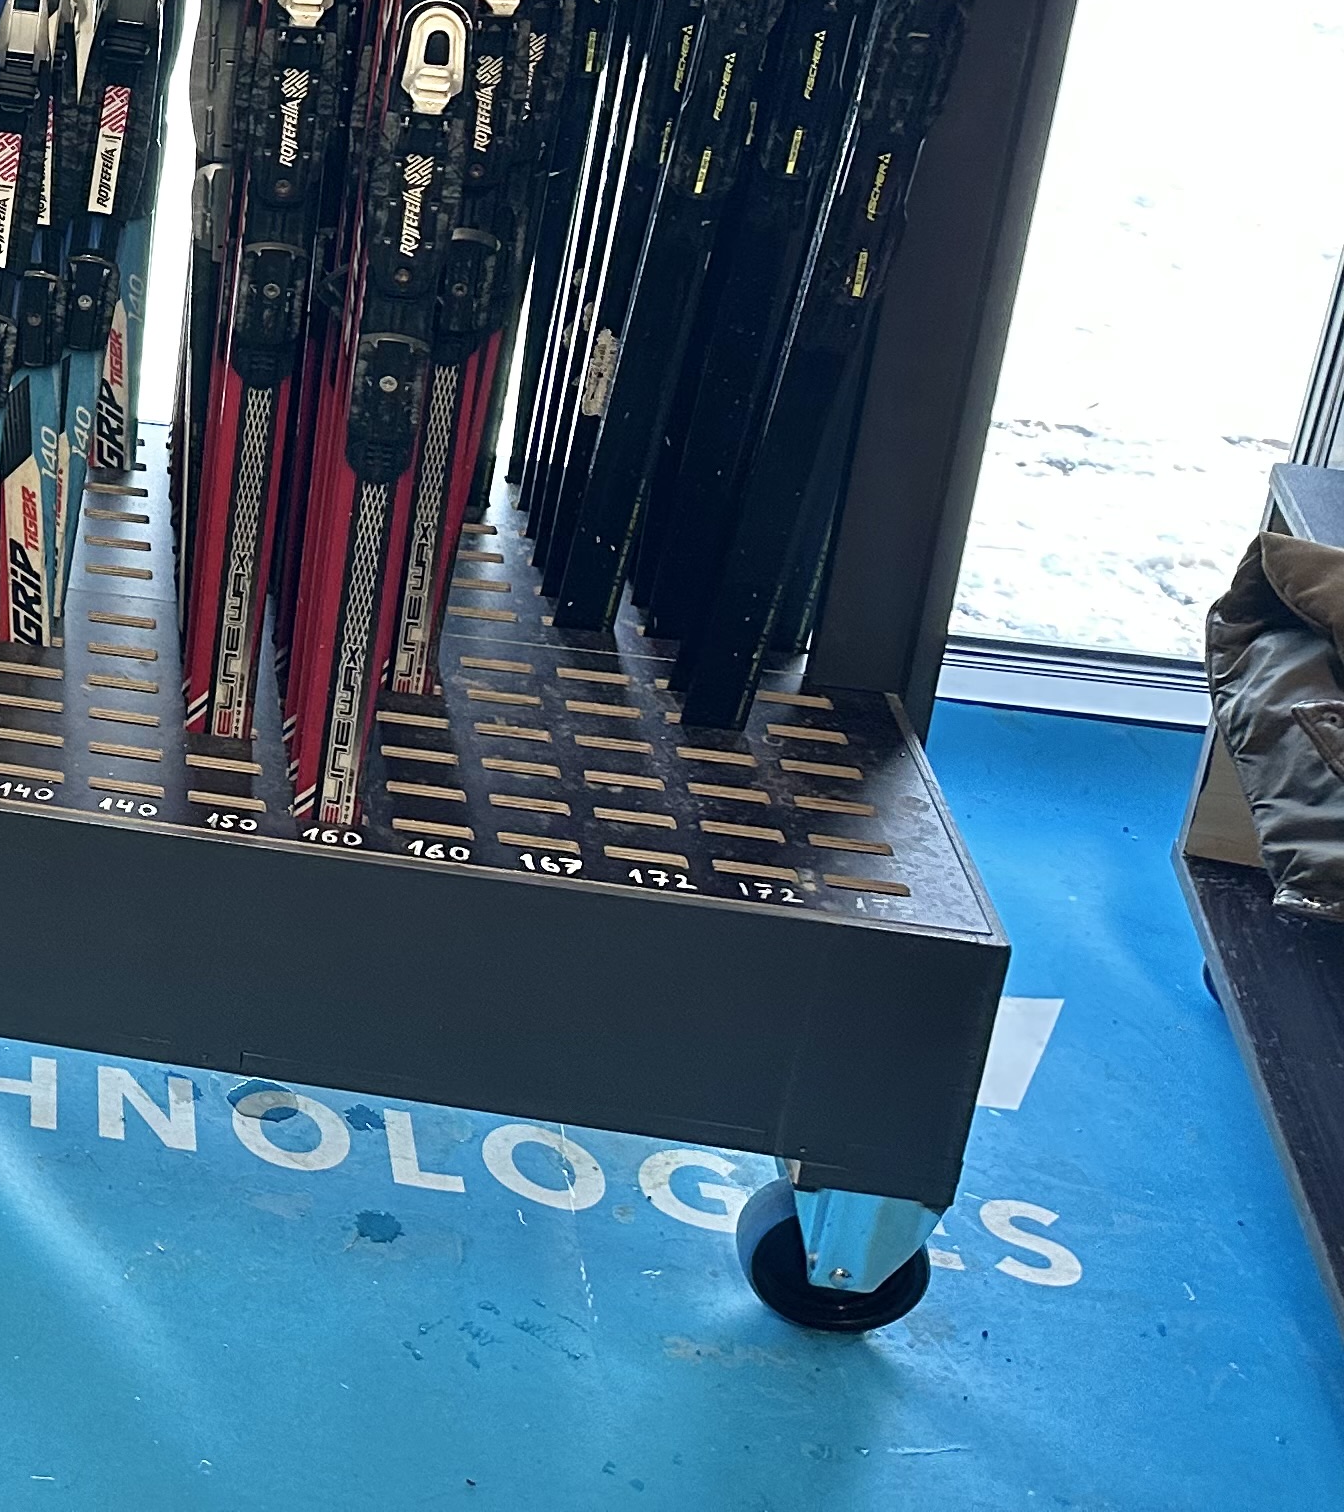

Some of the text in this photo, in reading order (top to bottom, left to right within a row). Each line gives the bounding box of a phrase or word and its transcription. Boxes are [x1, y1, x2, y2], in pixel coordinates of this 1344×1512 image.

[0, 780, 55, 802] 140
[99, 796, 159, 819] 140
[207, 812, 259, 833] 150
[302, 825, 363, 848] 160
[407, 838, 472, 863] 160
[519, 851, 583, 877] 167
[627, 867, 699, 890] 172
[737, 880, 805, 905] 172
